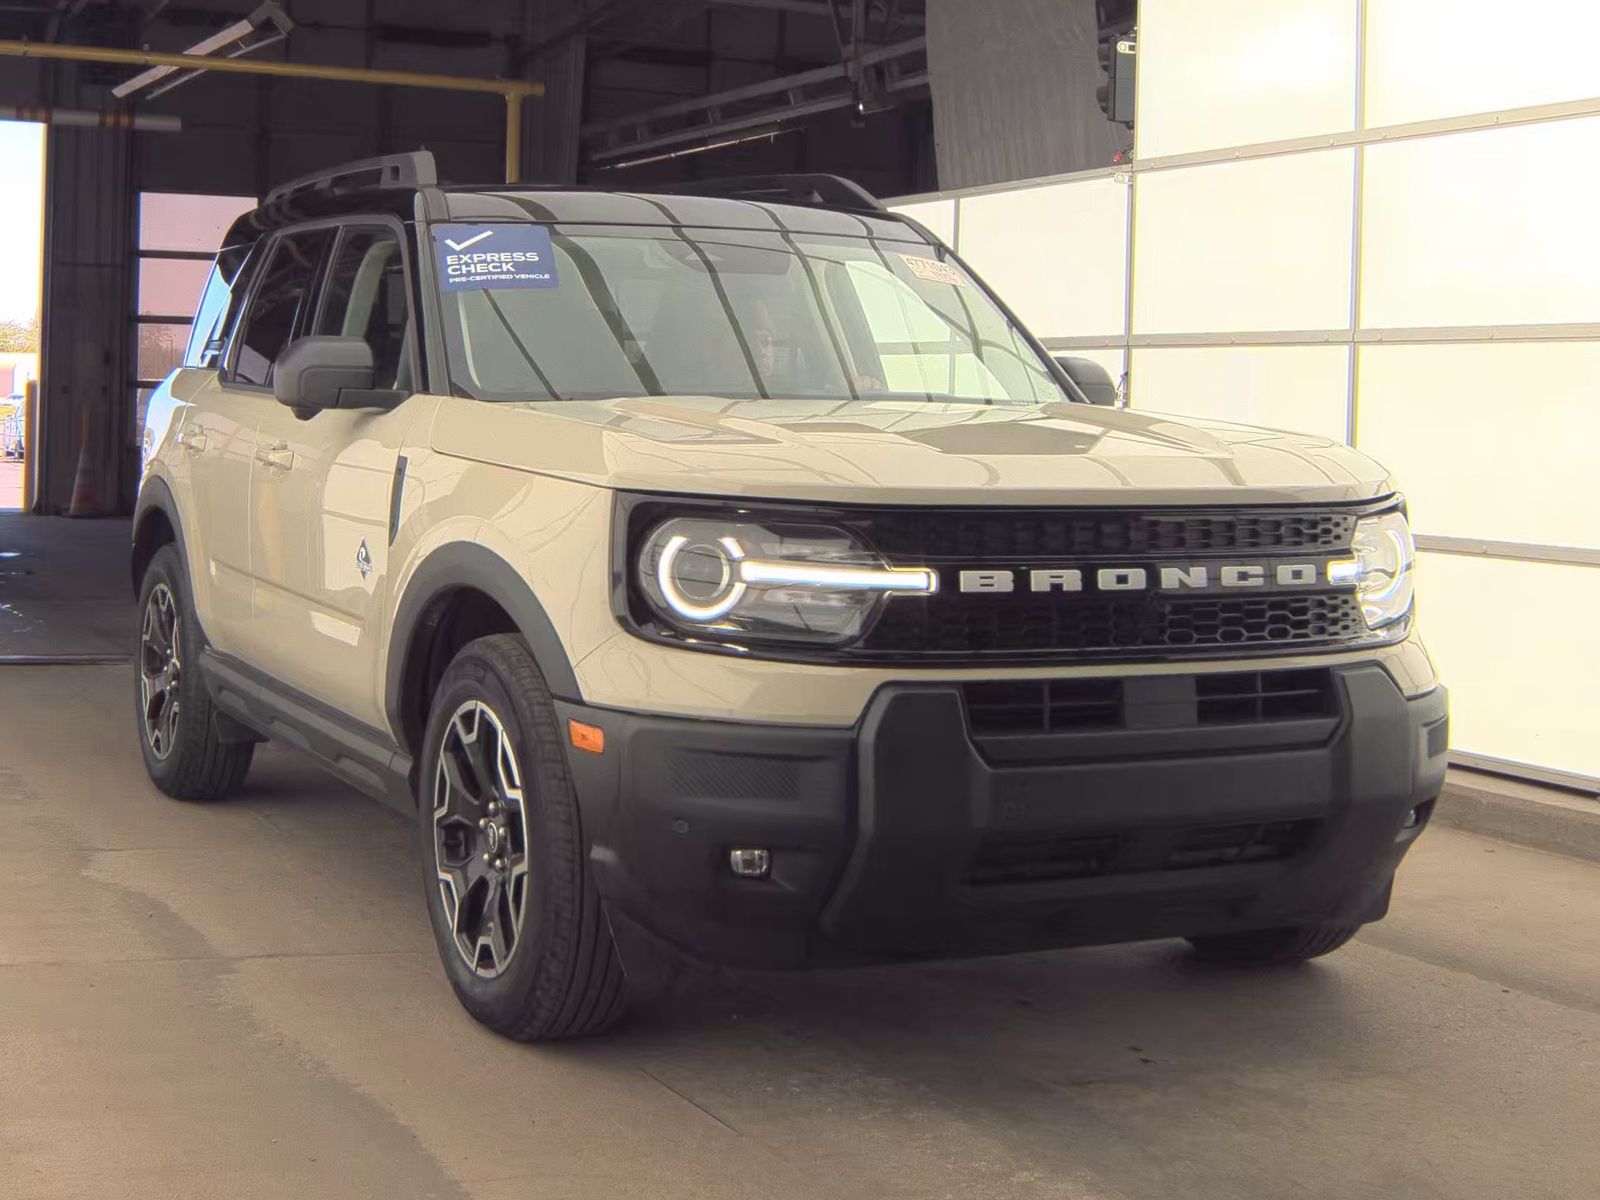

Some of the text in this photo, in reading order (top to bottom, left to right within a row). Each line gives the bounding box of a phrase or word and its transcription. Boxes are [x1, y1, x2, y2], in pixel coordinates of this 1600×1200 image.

[446, 252, 539, 265] EXPRESS
[447, 262, 516, 275] CHECK
[449, 274, 513, 283] PRE-CERTIFIED
[959, 564, 1317, 593] BRONCO
